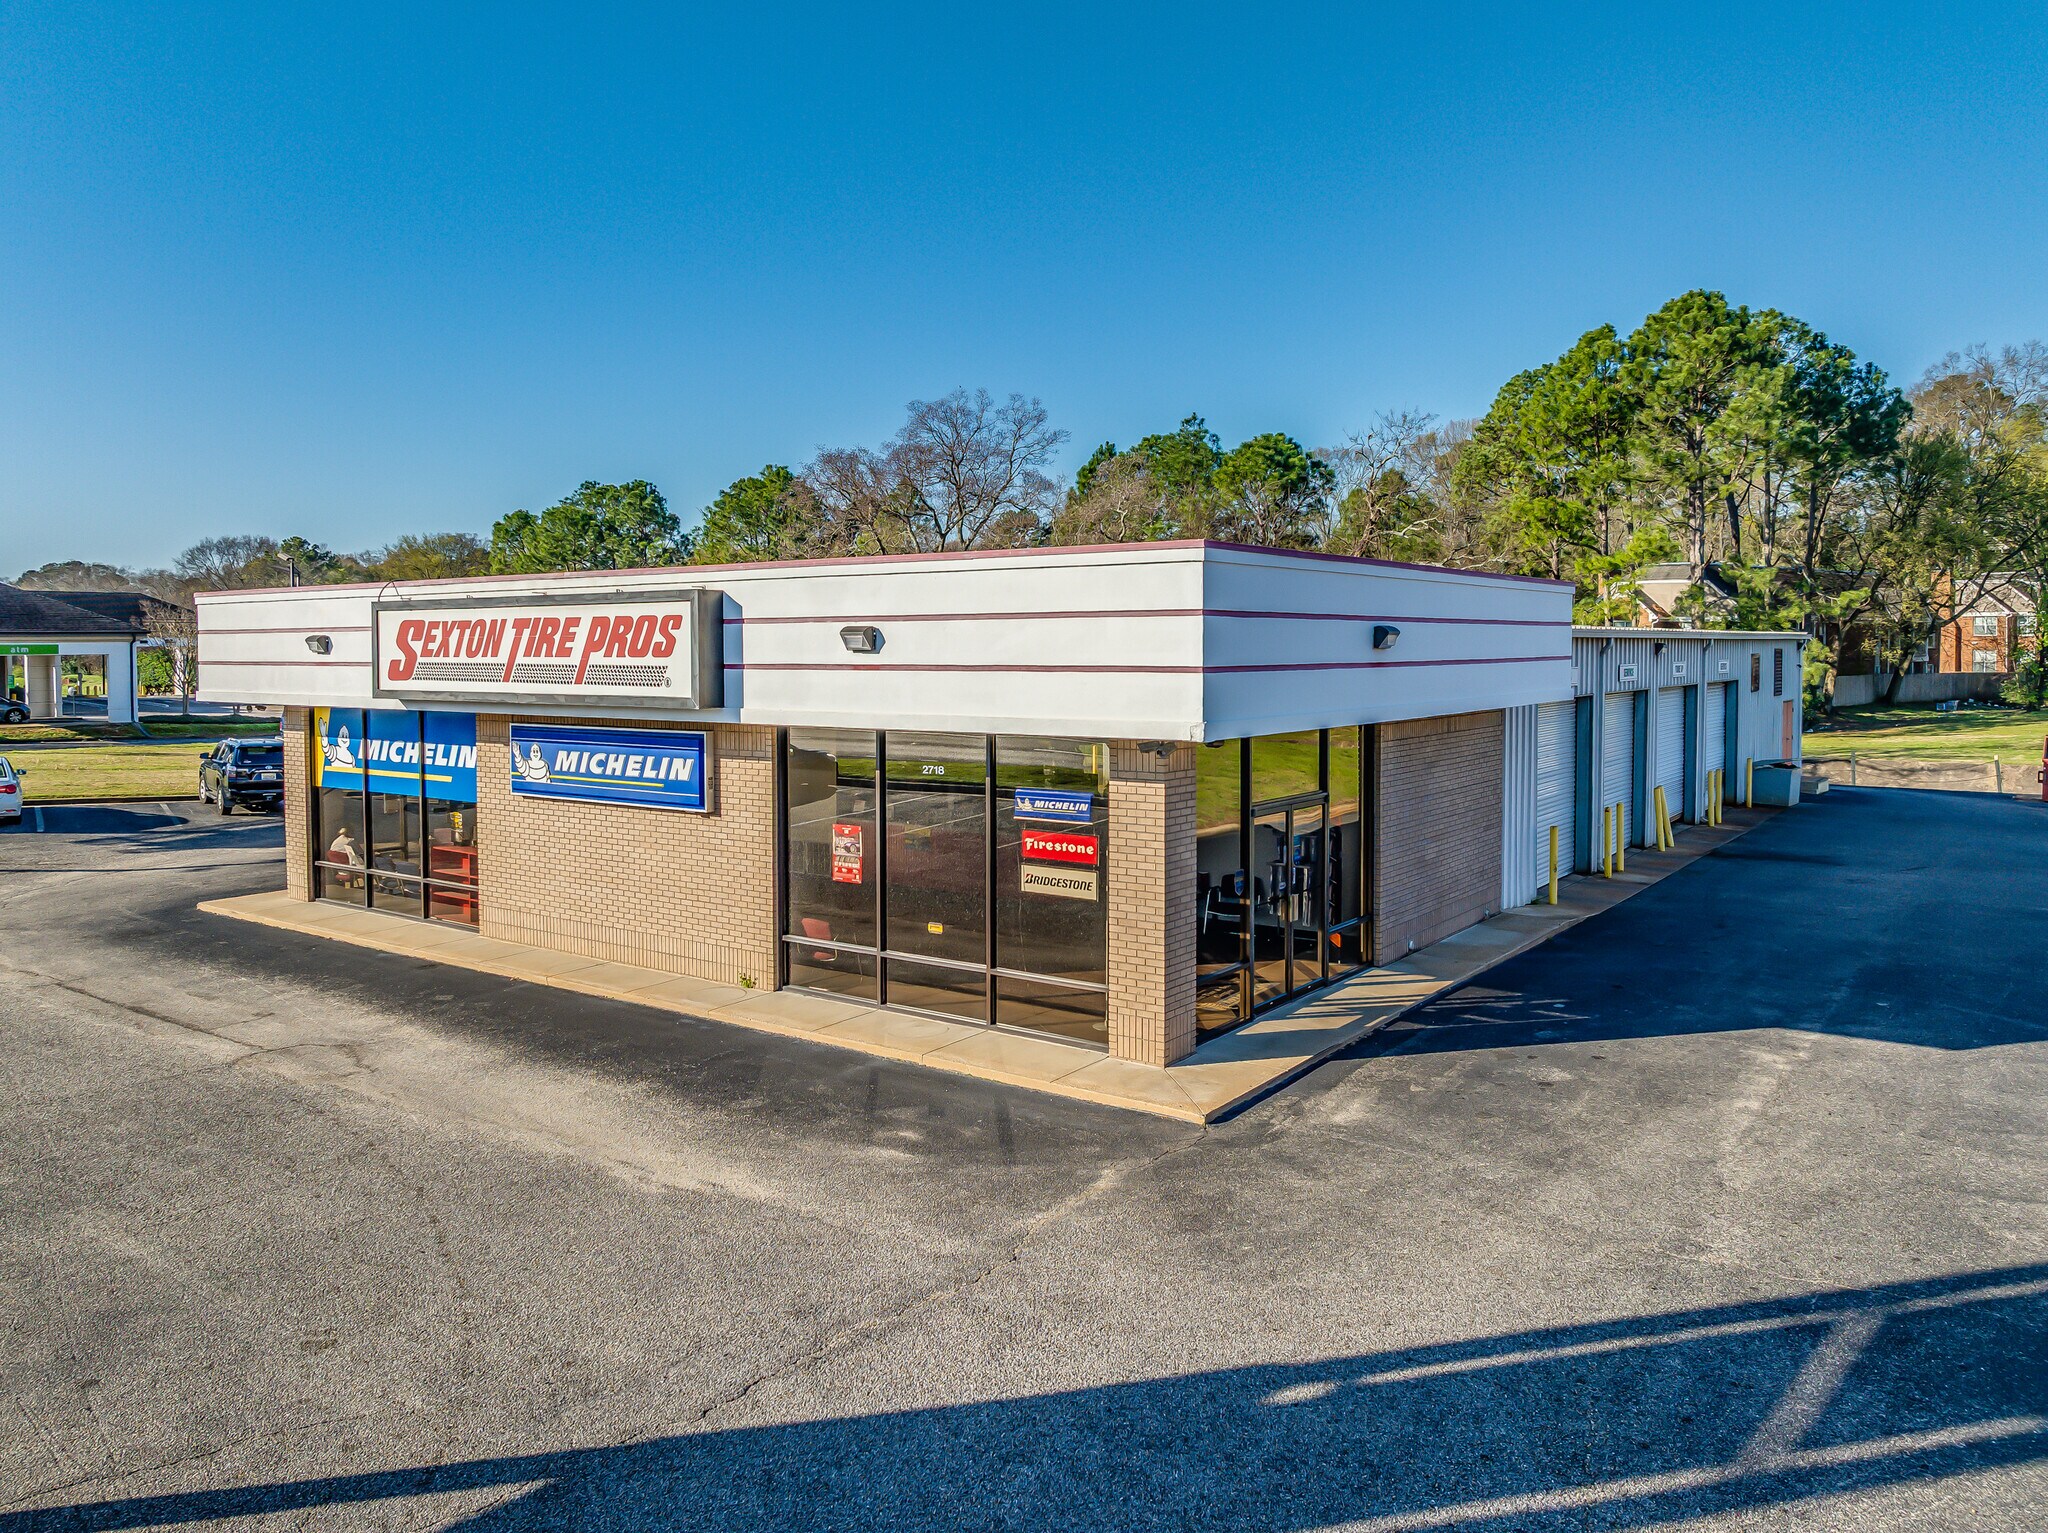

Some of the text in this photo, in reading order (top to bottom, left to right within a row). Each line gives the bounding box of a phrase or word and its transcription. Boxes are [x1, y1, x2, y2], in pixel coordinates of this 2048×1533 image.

[10, 646, 29, 654] atm
[388, 615, 683, 684] SEXTON TIRE PROS
[358, 738, 477, 769] MICHELIN
[554, 750, 694, 781] MICHELIN
[922, 765, 945, 775] 2718
[1034, 800, 1088, 811] MICHELIN
[1025, 838, 1094, 855] Firestone
[1025, 873, 1093, 891] BRIDGESTONE
